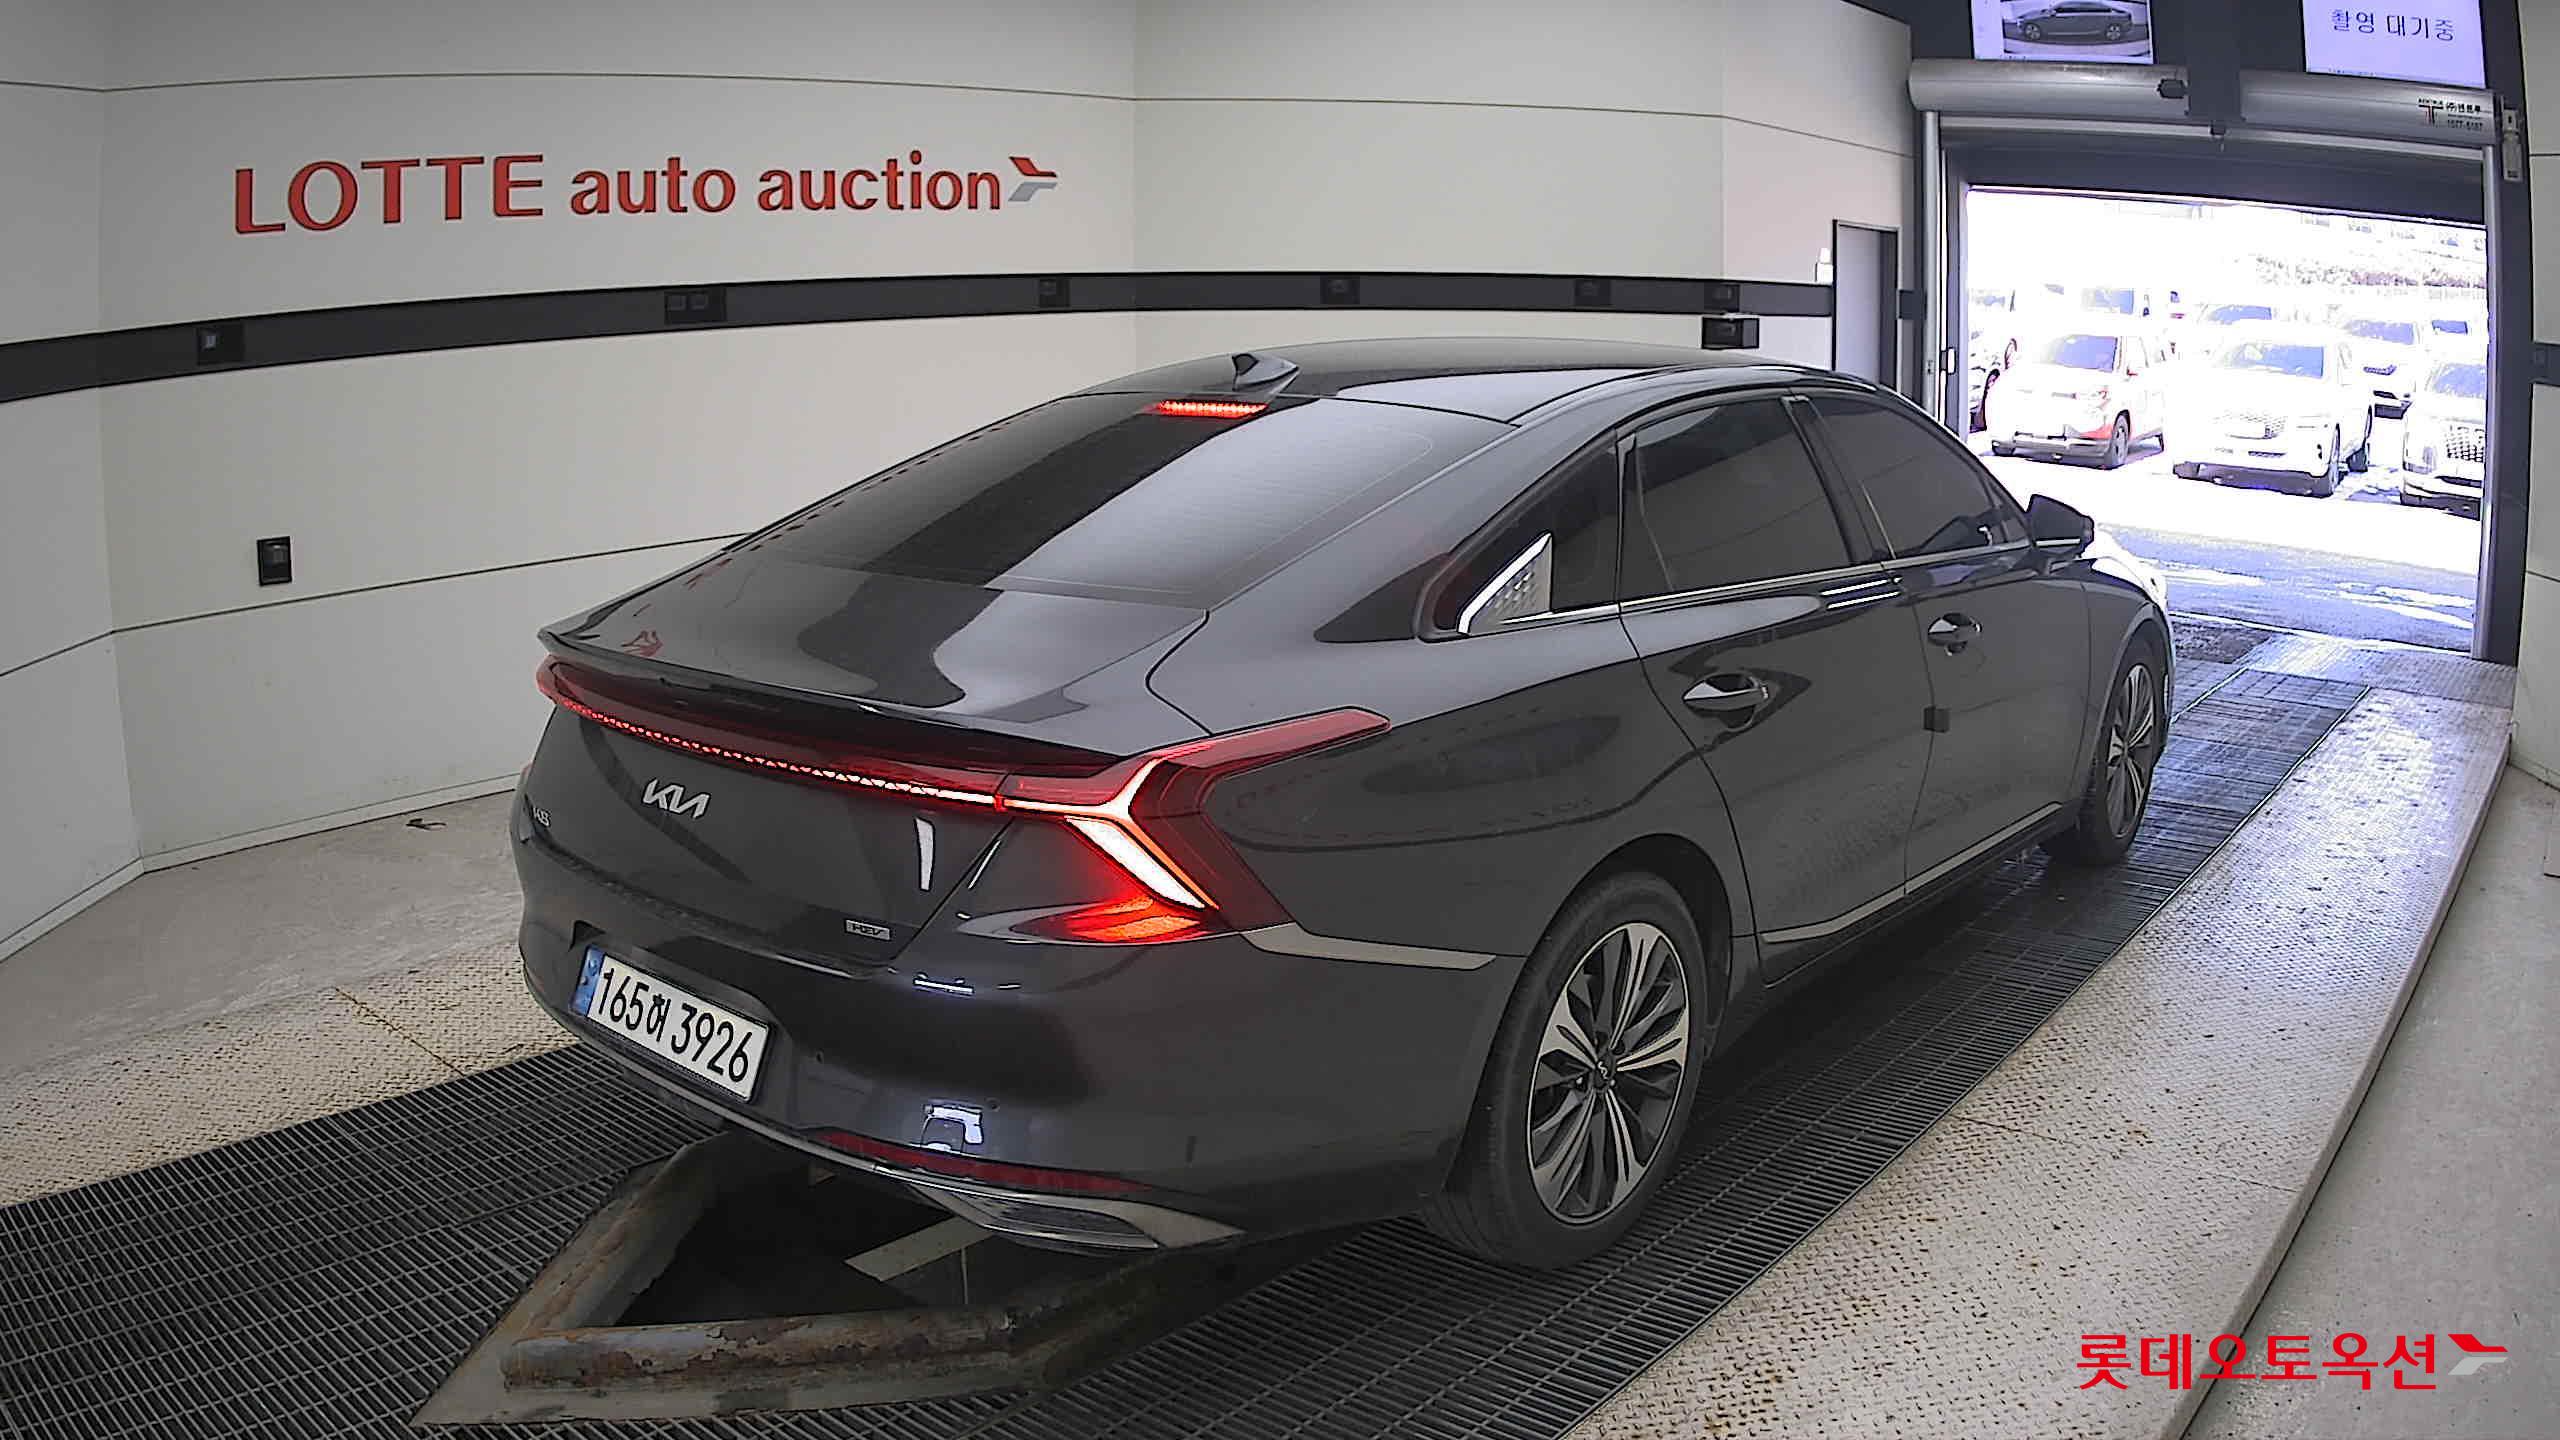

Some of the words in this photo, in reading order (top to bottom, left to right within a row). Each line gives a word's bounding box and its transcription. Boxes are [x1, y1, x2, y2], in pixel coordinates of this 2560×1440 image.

[2331, 10, 2375, 34] 촬영
[2386, 14, 2454, 42] 대기중
[236, 154, 544, 233] LOTTE
[570, 155, 736, 215] auto
[757, 149, 1001, 212] auction
[642, 778, 711, 820] KIA
[670, 1002, 753, 1083] 3926
